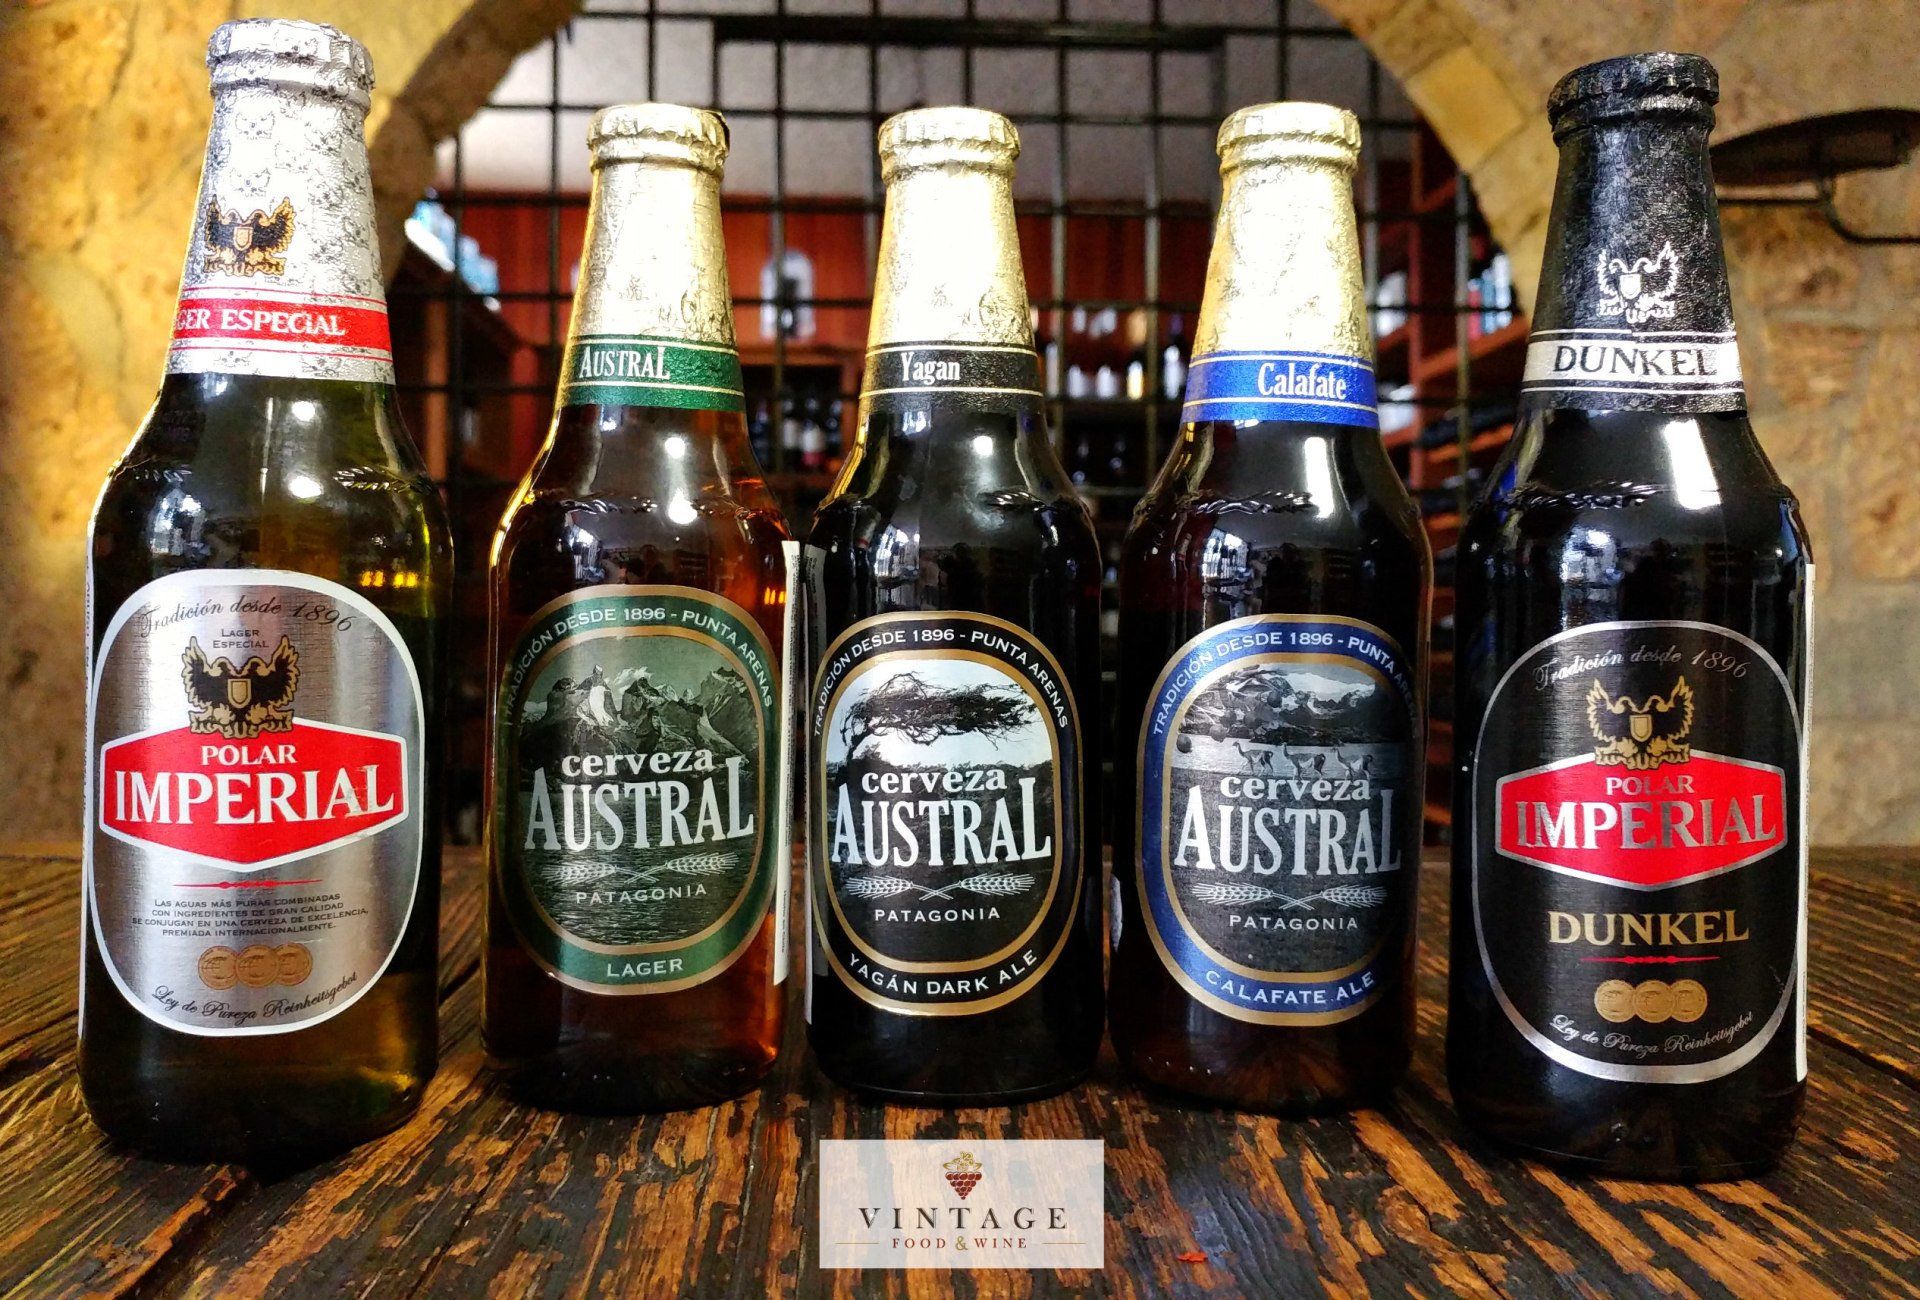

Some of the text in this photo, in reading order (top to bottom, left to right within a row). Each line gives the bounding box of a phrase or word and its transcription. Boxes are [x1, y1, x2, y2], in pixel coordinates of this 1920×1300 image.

[221, 309, 346, 336] ESPECIAL
[579, 346, 670, 379] AUSTRAL
[901, 352, 961, 385] Yagan
[1553, 344, 1718, 376] DUNKEL
[1257, 362, 1347, 399] Calafate
[140, 594, 354, 638] Tradición desde 1896
[221, 628, 260, 637] LAGER
[212, 640, 270, 649] ESPECIAL
[555, 608, 616, 635] DESDE
[623, 608, 666, 621] 1896
[682, 610, 738, 646] PUNTA
[738, 642, 773, 708] ARENAS
[814, 653, 851, 737] TRADICIÓN
[851, 630, 906, 658] DESDE
[912, 629, 955, 642] 1896
[971, 630, 1028, 665] PUNTA
[1028, 662, 1068, 729] ARENAS
[1153, 651, 1215, 735] TRADICIÓN
[1215, 632, 1283, 657] DESDE
[1289, 632, 1333, 646] 1896
[1348, 636, 1395, 674] PUNTA
[1532, 643, 1750, 691] Tradición desde 1896
[201, 744, 298, 767] POLAR
[561, 749, 716, 777] cerveza
[114, 764, 395, 824] IMPERIAL
[861, 769, 1007, 794] cerveza
[1220, 776, 1371, 801] cerveza
[1605, 774, 1695, 796] POLAR
[524, 755, 754, 851] AUSTRAL
[831, 777, 1051, 867] AUSTRAL
[1174, 784, 1400, 875] AUSTRAL
[1515, 794, 1777, 849] IMPERIAL
[152, 902, 344, 918] CON INGREDIENTES DE GRAN CALIDAD
[175, 900, 207, 908] AGUAS
[211, 899, 232, 908] MÁS
[236, 899, 271, 907] PURAS
[275, 893, 341, 905] COMBINADAS
[575, 883, 707, 904] PATAGONIA
[132, 917, 143, 925] SE
[145, 919, 194, 927] CONJUGAN
[240, 917, 287, 926] CERVEZA
[290, 916, 305, 924] DE
[307, 908, 369, 922] EXCELENCIA,
[162, 922, 337, 937] PREMIADA INTERNACIONALMENTE.
[874, 907, 1000, 922] PATAGONIA
[1229, 914, 1359, 930] PATAGONIA
[1548, 910, 1749, 946] DUNKEL
[607, 958, 684, 977] LAGER
[850, 949, 1038, 995] YAGÁN DARK ALE
[152, 973, 358, 1027] Ley de Pureza Reinheitsgebot
[1205, 970, 1375, 1005] CALAFATE ALE
[1549, 1012, 1753, 1059] Ley de Pureza Reinheitsgebot
